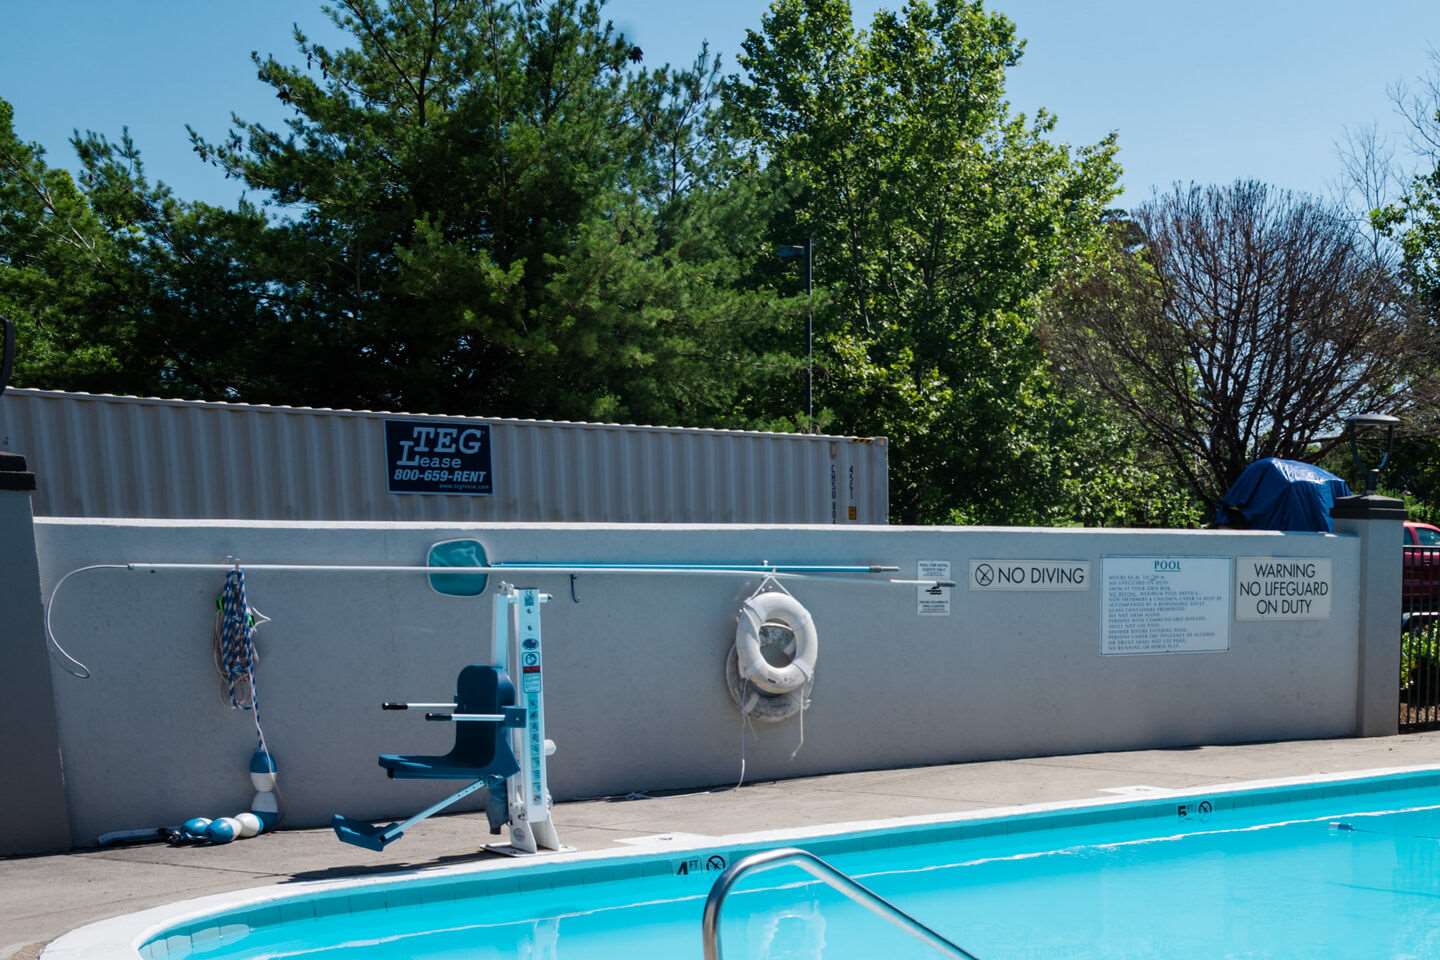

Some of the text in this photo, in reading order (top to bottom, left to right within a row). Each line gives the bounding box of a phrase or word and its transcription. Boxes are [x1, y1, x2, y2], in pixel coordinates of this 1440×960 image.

[413, 426, 482, 454] TEG
[396, 441, 462, 468] Lease
[394, 469, 486, 483] 800-659-RENT
[1154, 560, 1181, 571] POOL
[1254, 563, 1316, 578] WARNING
[998, 567, 1085, 584] NO DIVING
[1240, 581, 1329, 596] NO LIFEGUARD
[1256, 599, 1312, 615] ON DUTY
